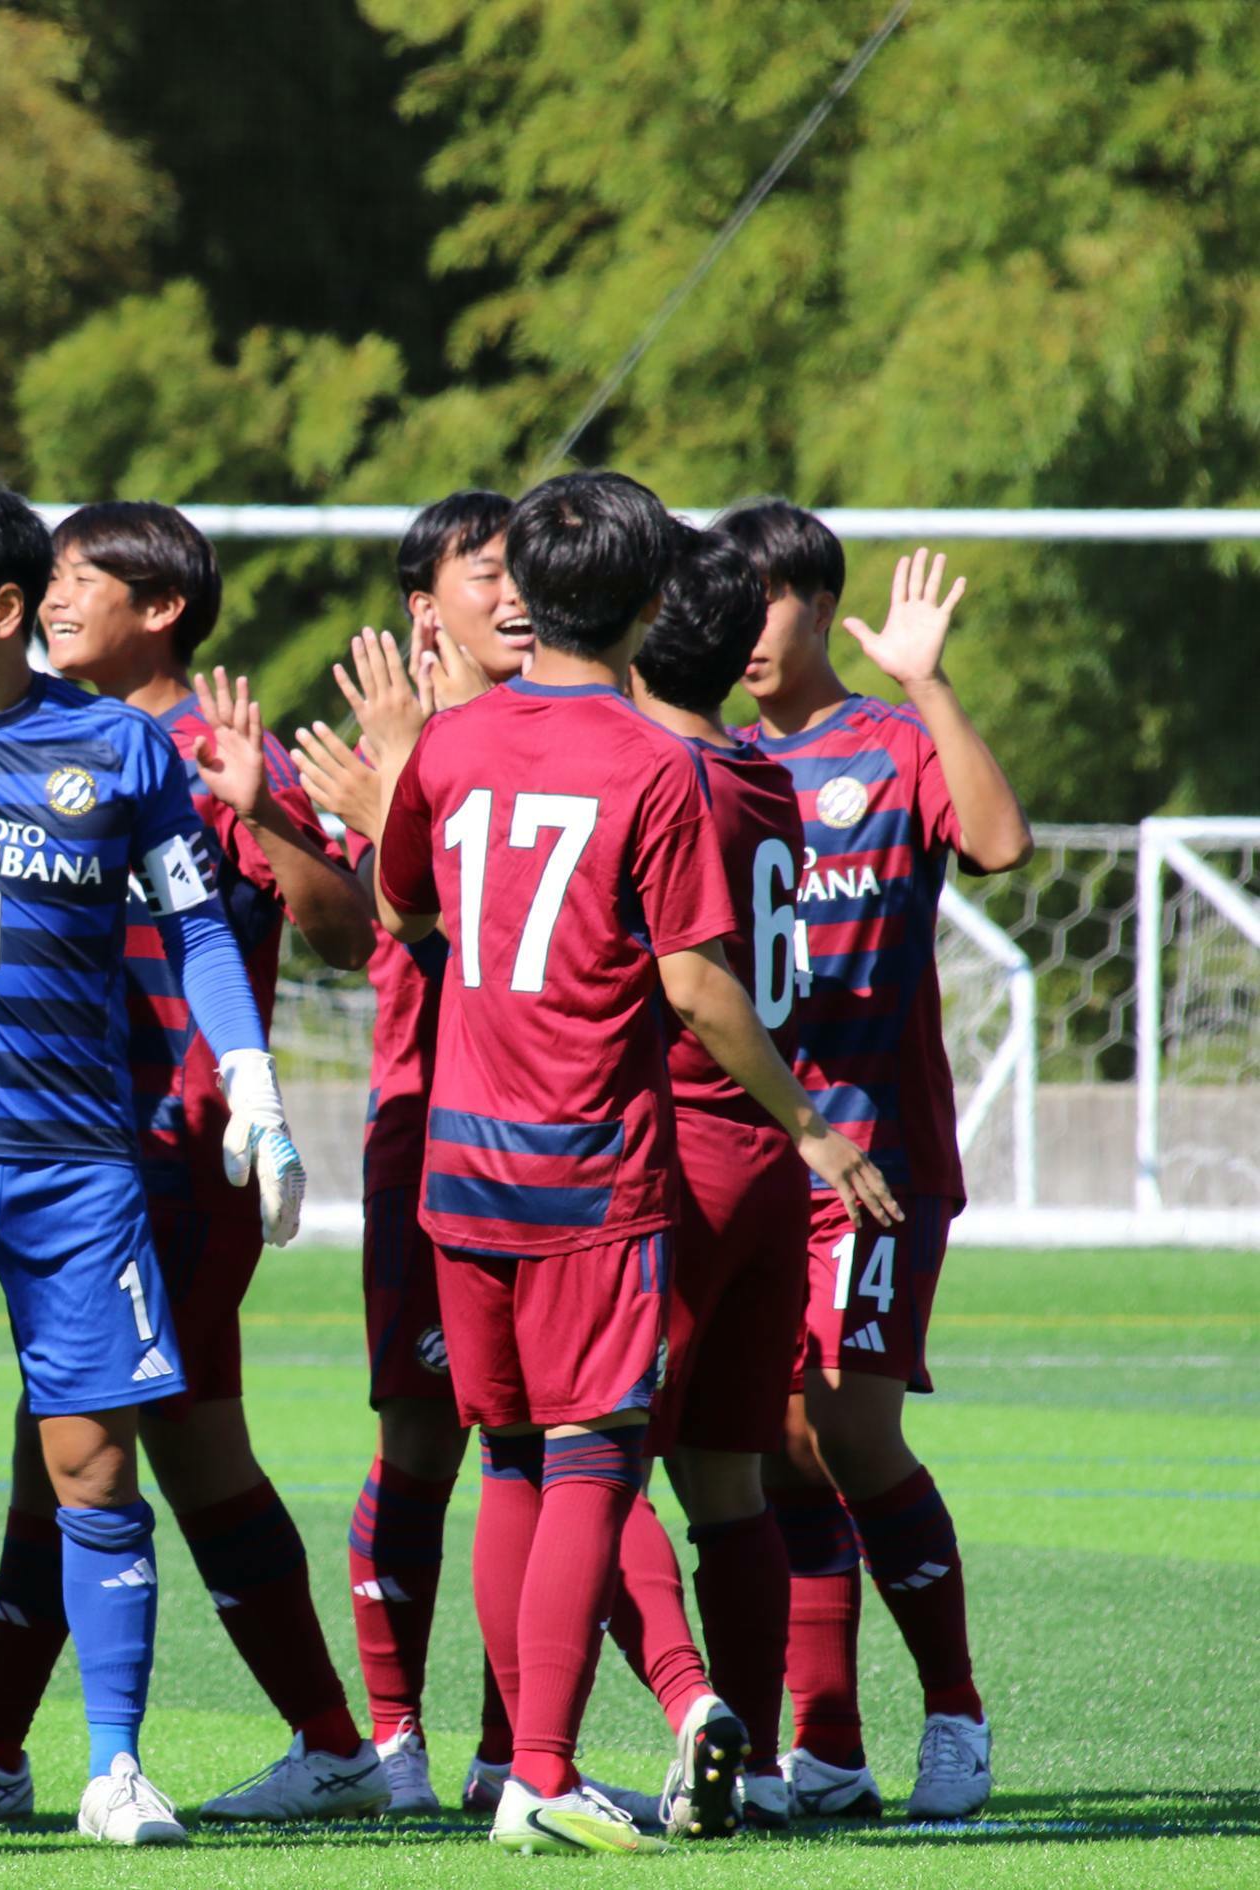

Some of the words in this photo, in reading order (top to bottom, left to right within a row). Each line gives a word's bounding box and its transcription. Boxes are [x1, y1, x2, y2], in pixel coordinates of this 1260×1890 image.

[444, 788, 599, 993] 17
[752, 838, 795, 1029] 6
[118, 1260, 154, 1342] 1
[831, 1232, 896, 1313] 14
